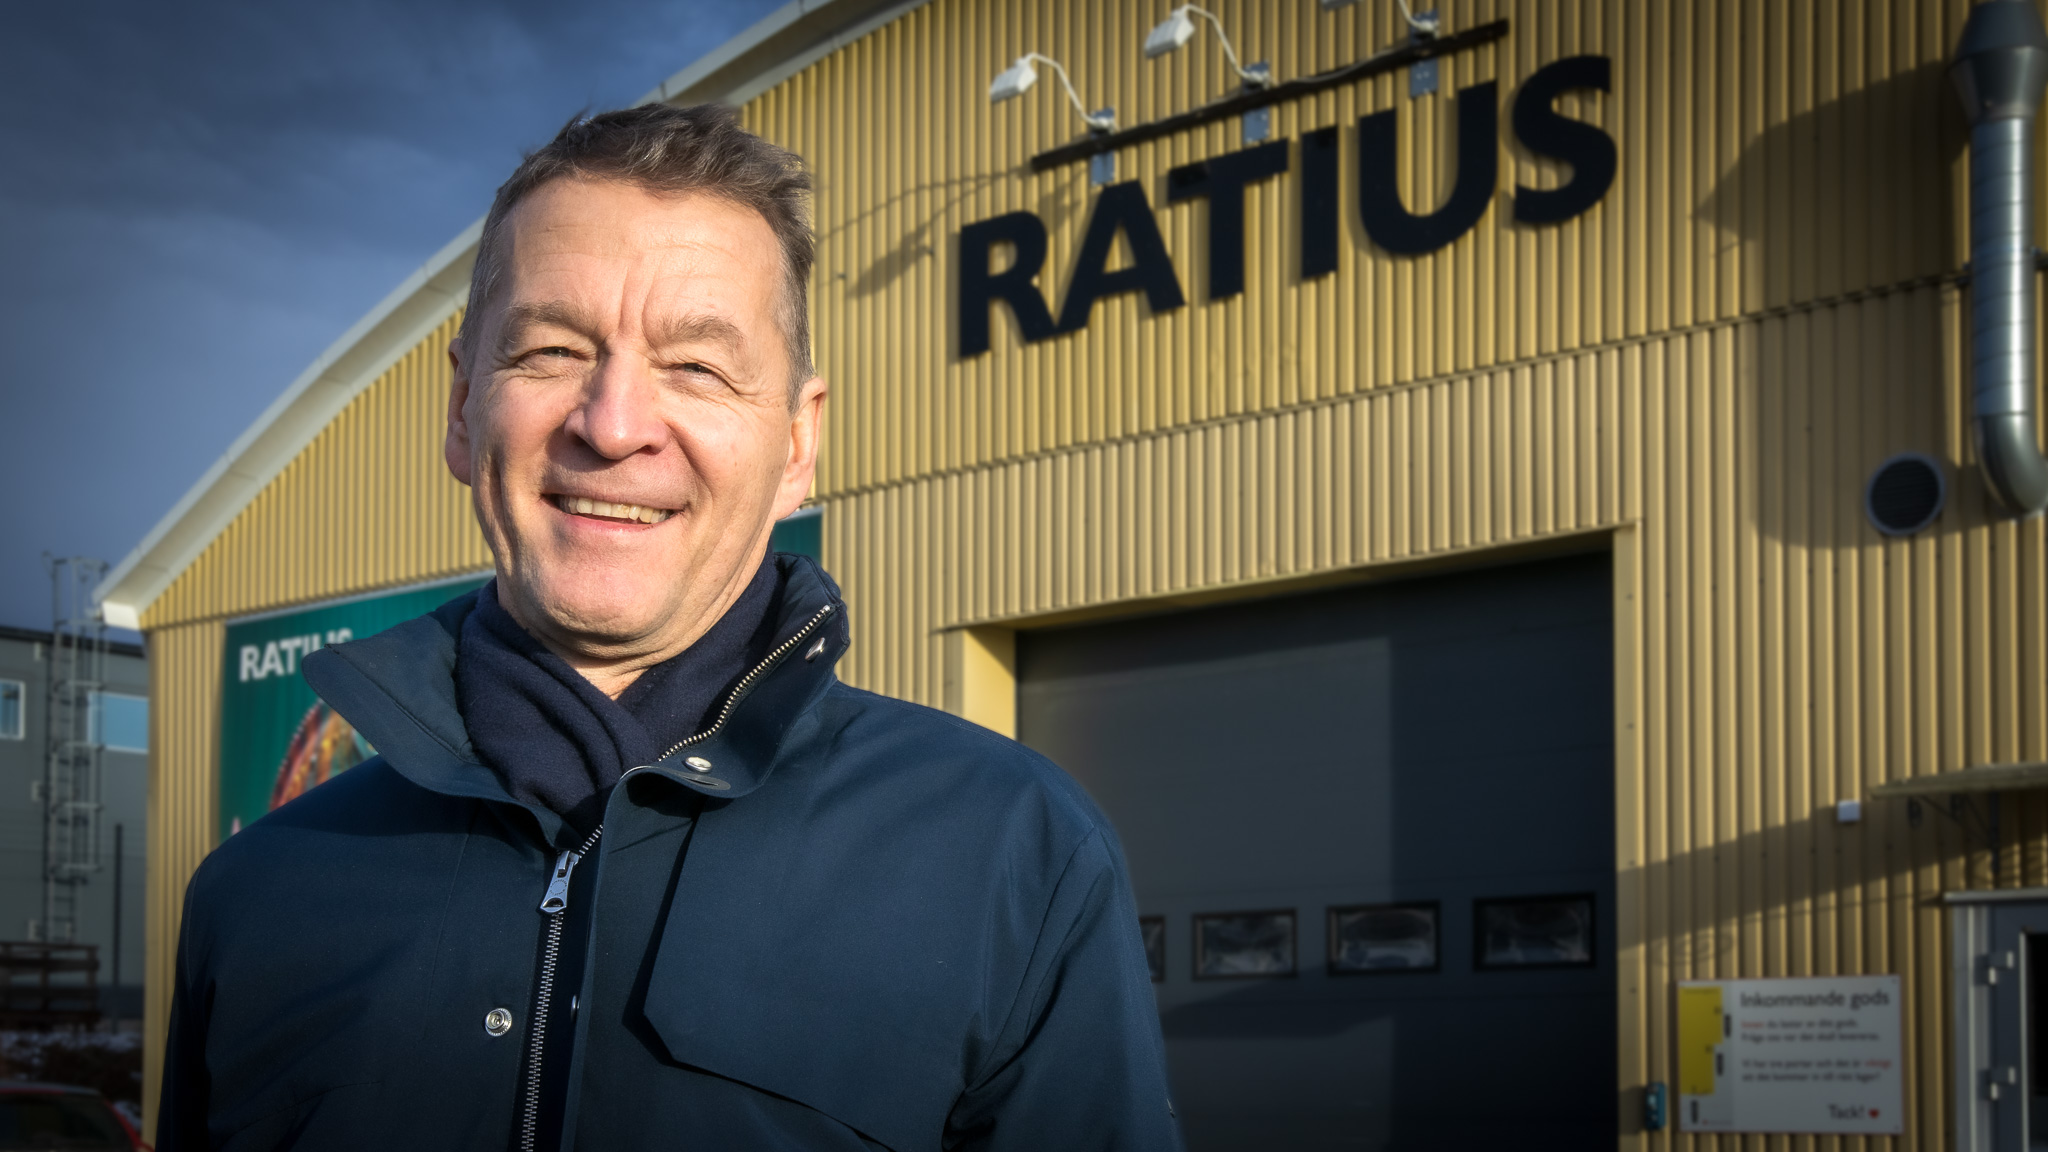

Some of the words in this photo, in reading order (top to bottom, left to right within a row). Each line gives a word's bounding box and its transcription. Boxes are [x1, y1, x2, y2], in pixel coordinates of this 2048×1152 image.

[959, 53, 1618, 361] RATIUS
[1740, 989, 1845, 1008] Inkommande
[1850, 987, 1890, 1010] gods
[1828, 1103, 1866, 1120] Tack!
